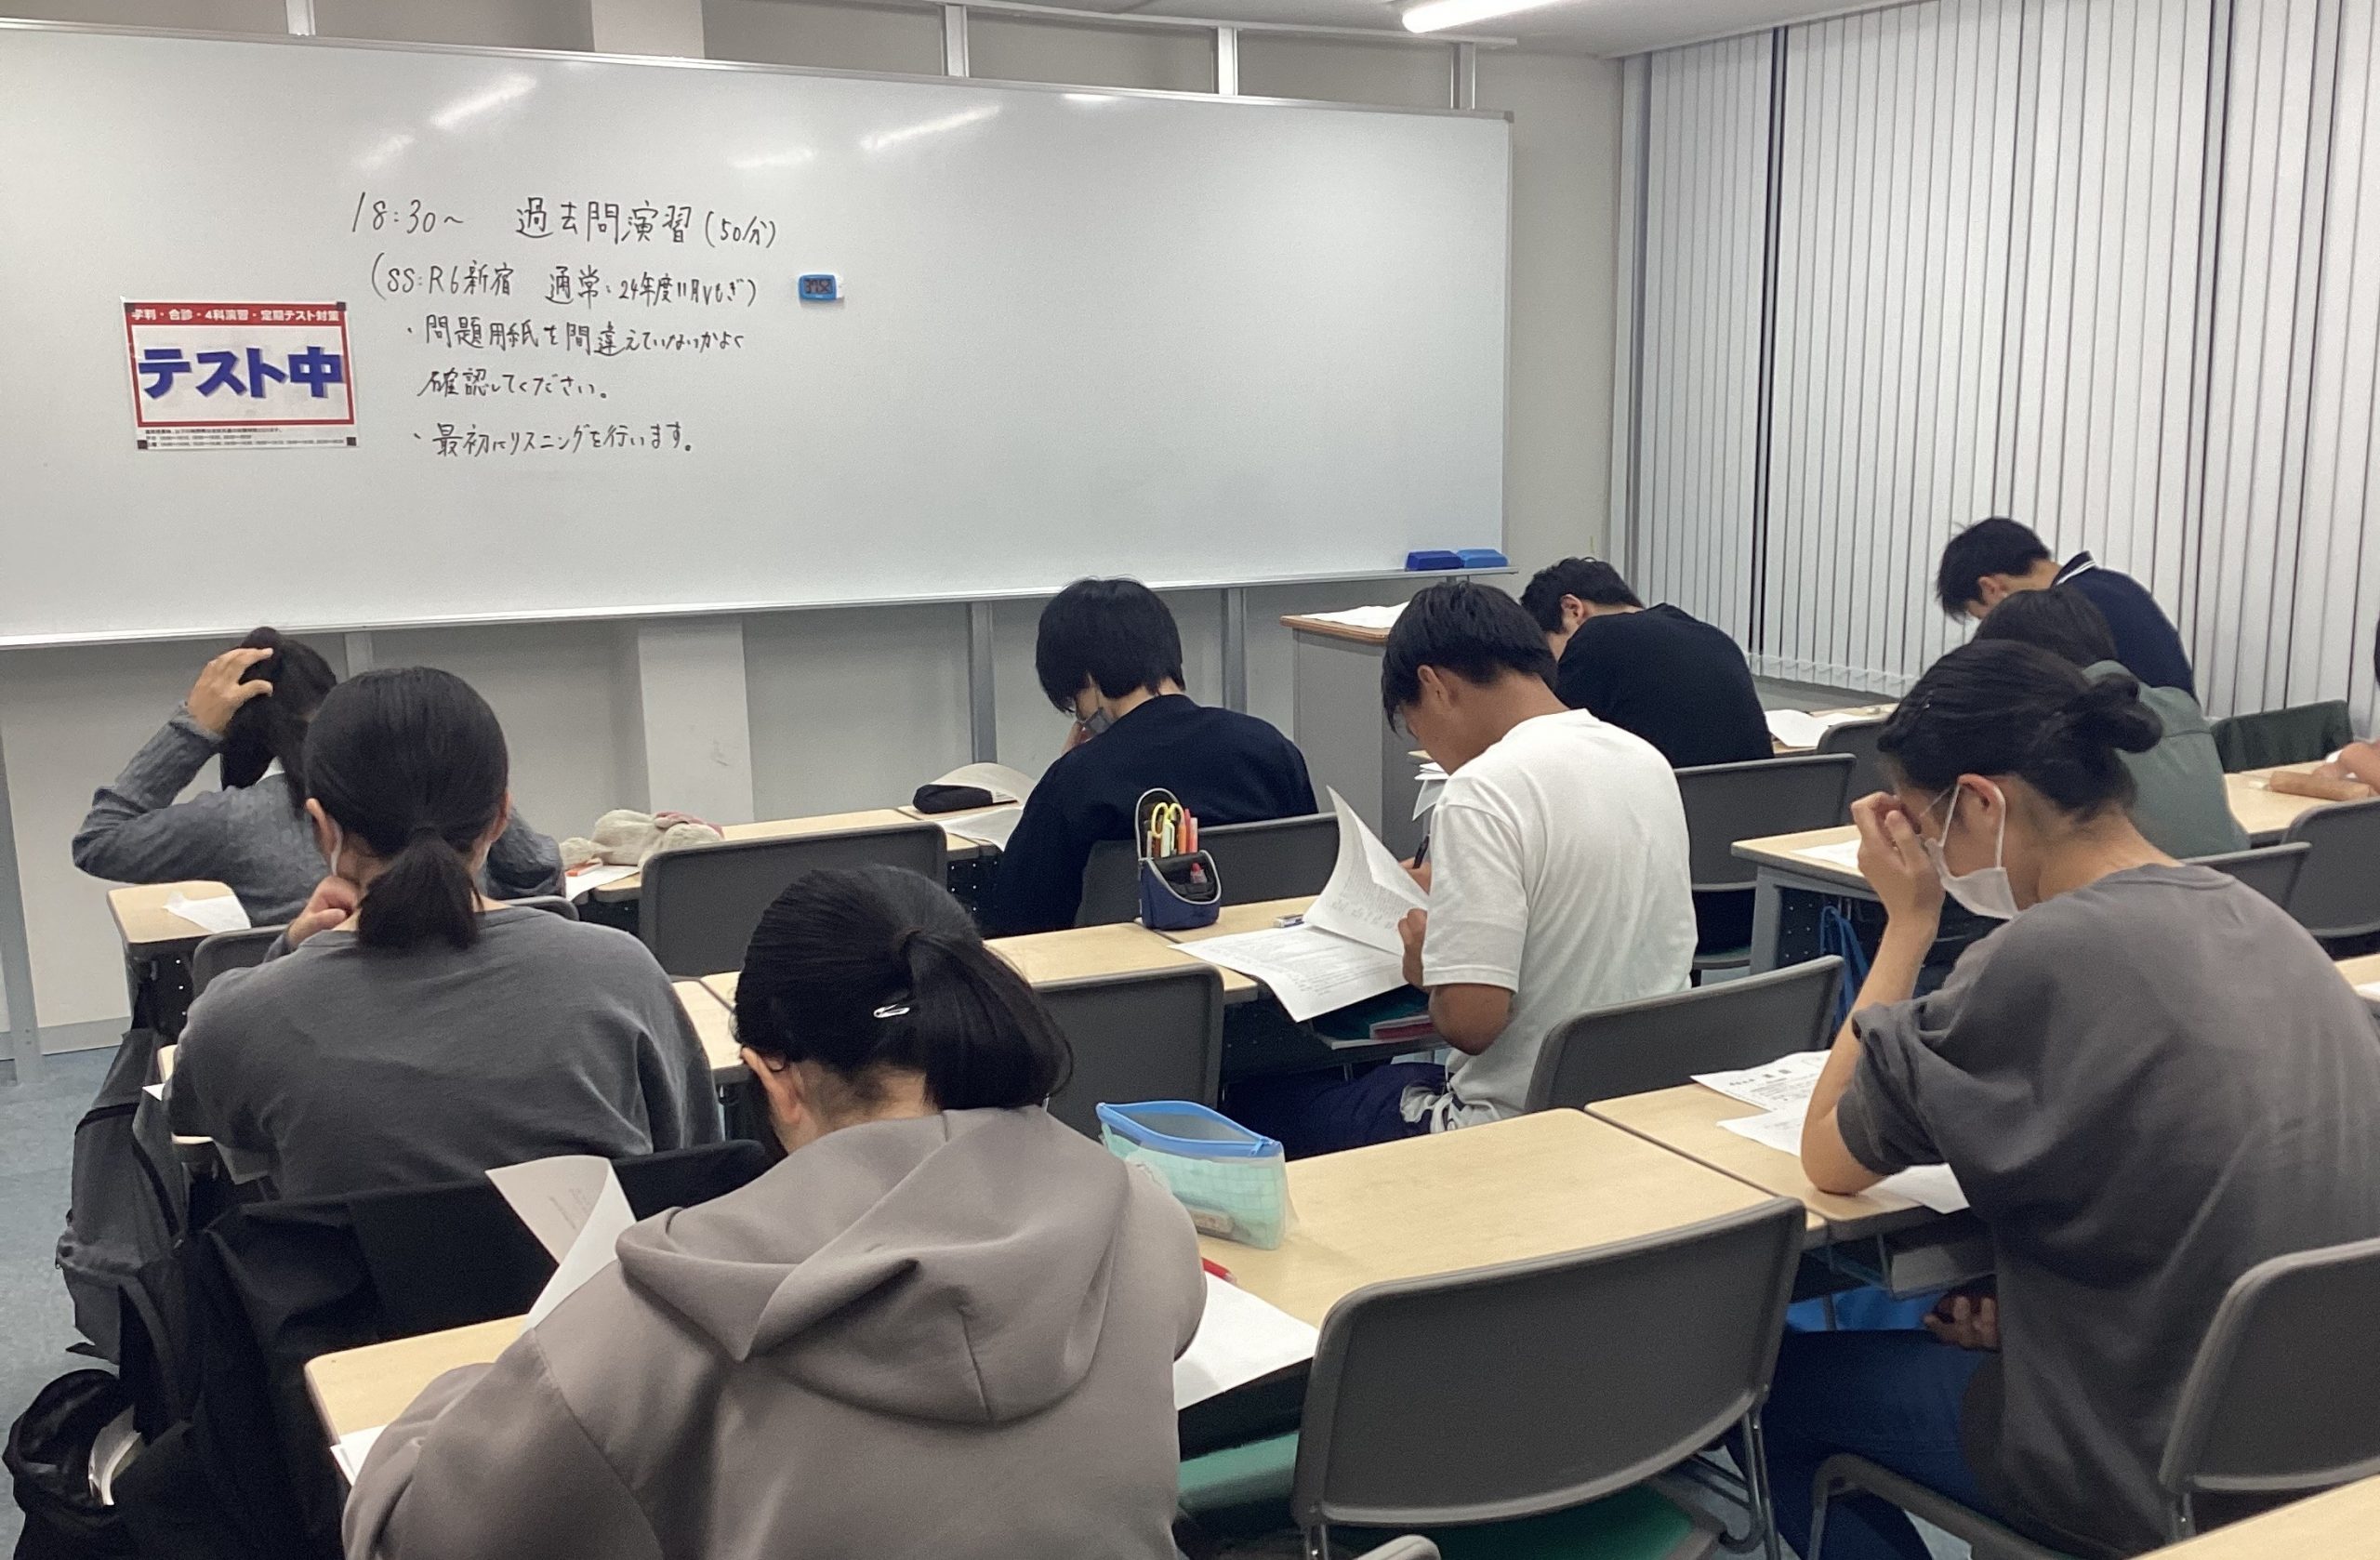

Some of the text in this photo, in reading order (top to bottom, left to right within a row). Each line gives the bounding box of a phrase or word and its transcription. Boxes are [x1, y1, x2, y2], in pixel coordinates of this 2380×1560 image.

[138, 345, 345, 400] テスト中
[417, 367, 608, 400] 確認してください。
